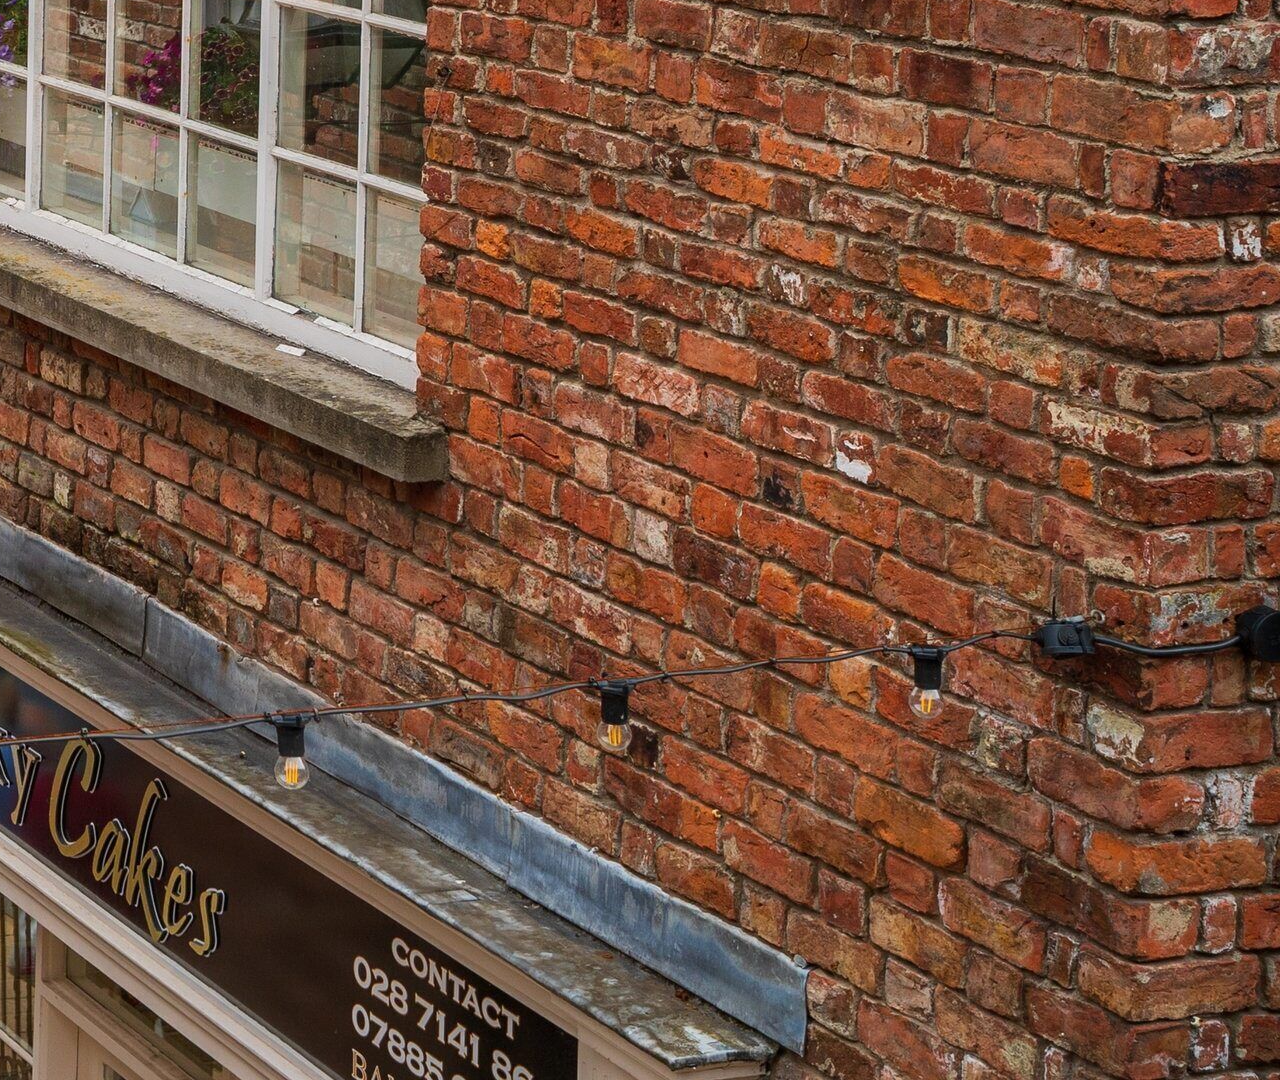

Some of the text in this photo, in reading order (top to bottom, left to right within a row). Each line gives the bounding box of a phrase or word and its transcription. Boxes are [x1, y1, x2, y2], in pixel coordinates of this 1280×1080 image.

[49, 739, 227, 958] Cakes
[351, 1003, 445, 1080] 07885
[353, 956, 409, 1016] 028
[414, 993, 480, 1068] 7141
[391, 937, 521, 1040] CONTACT
